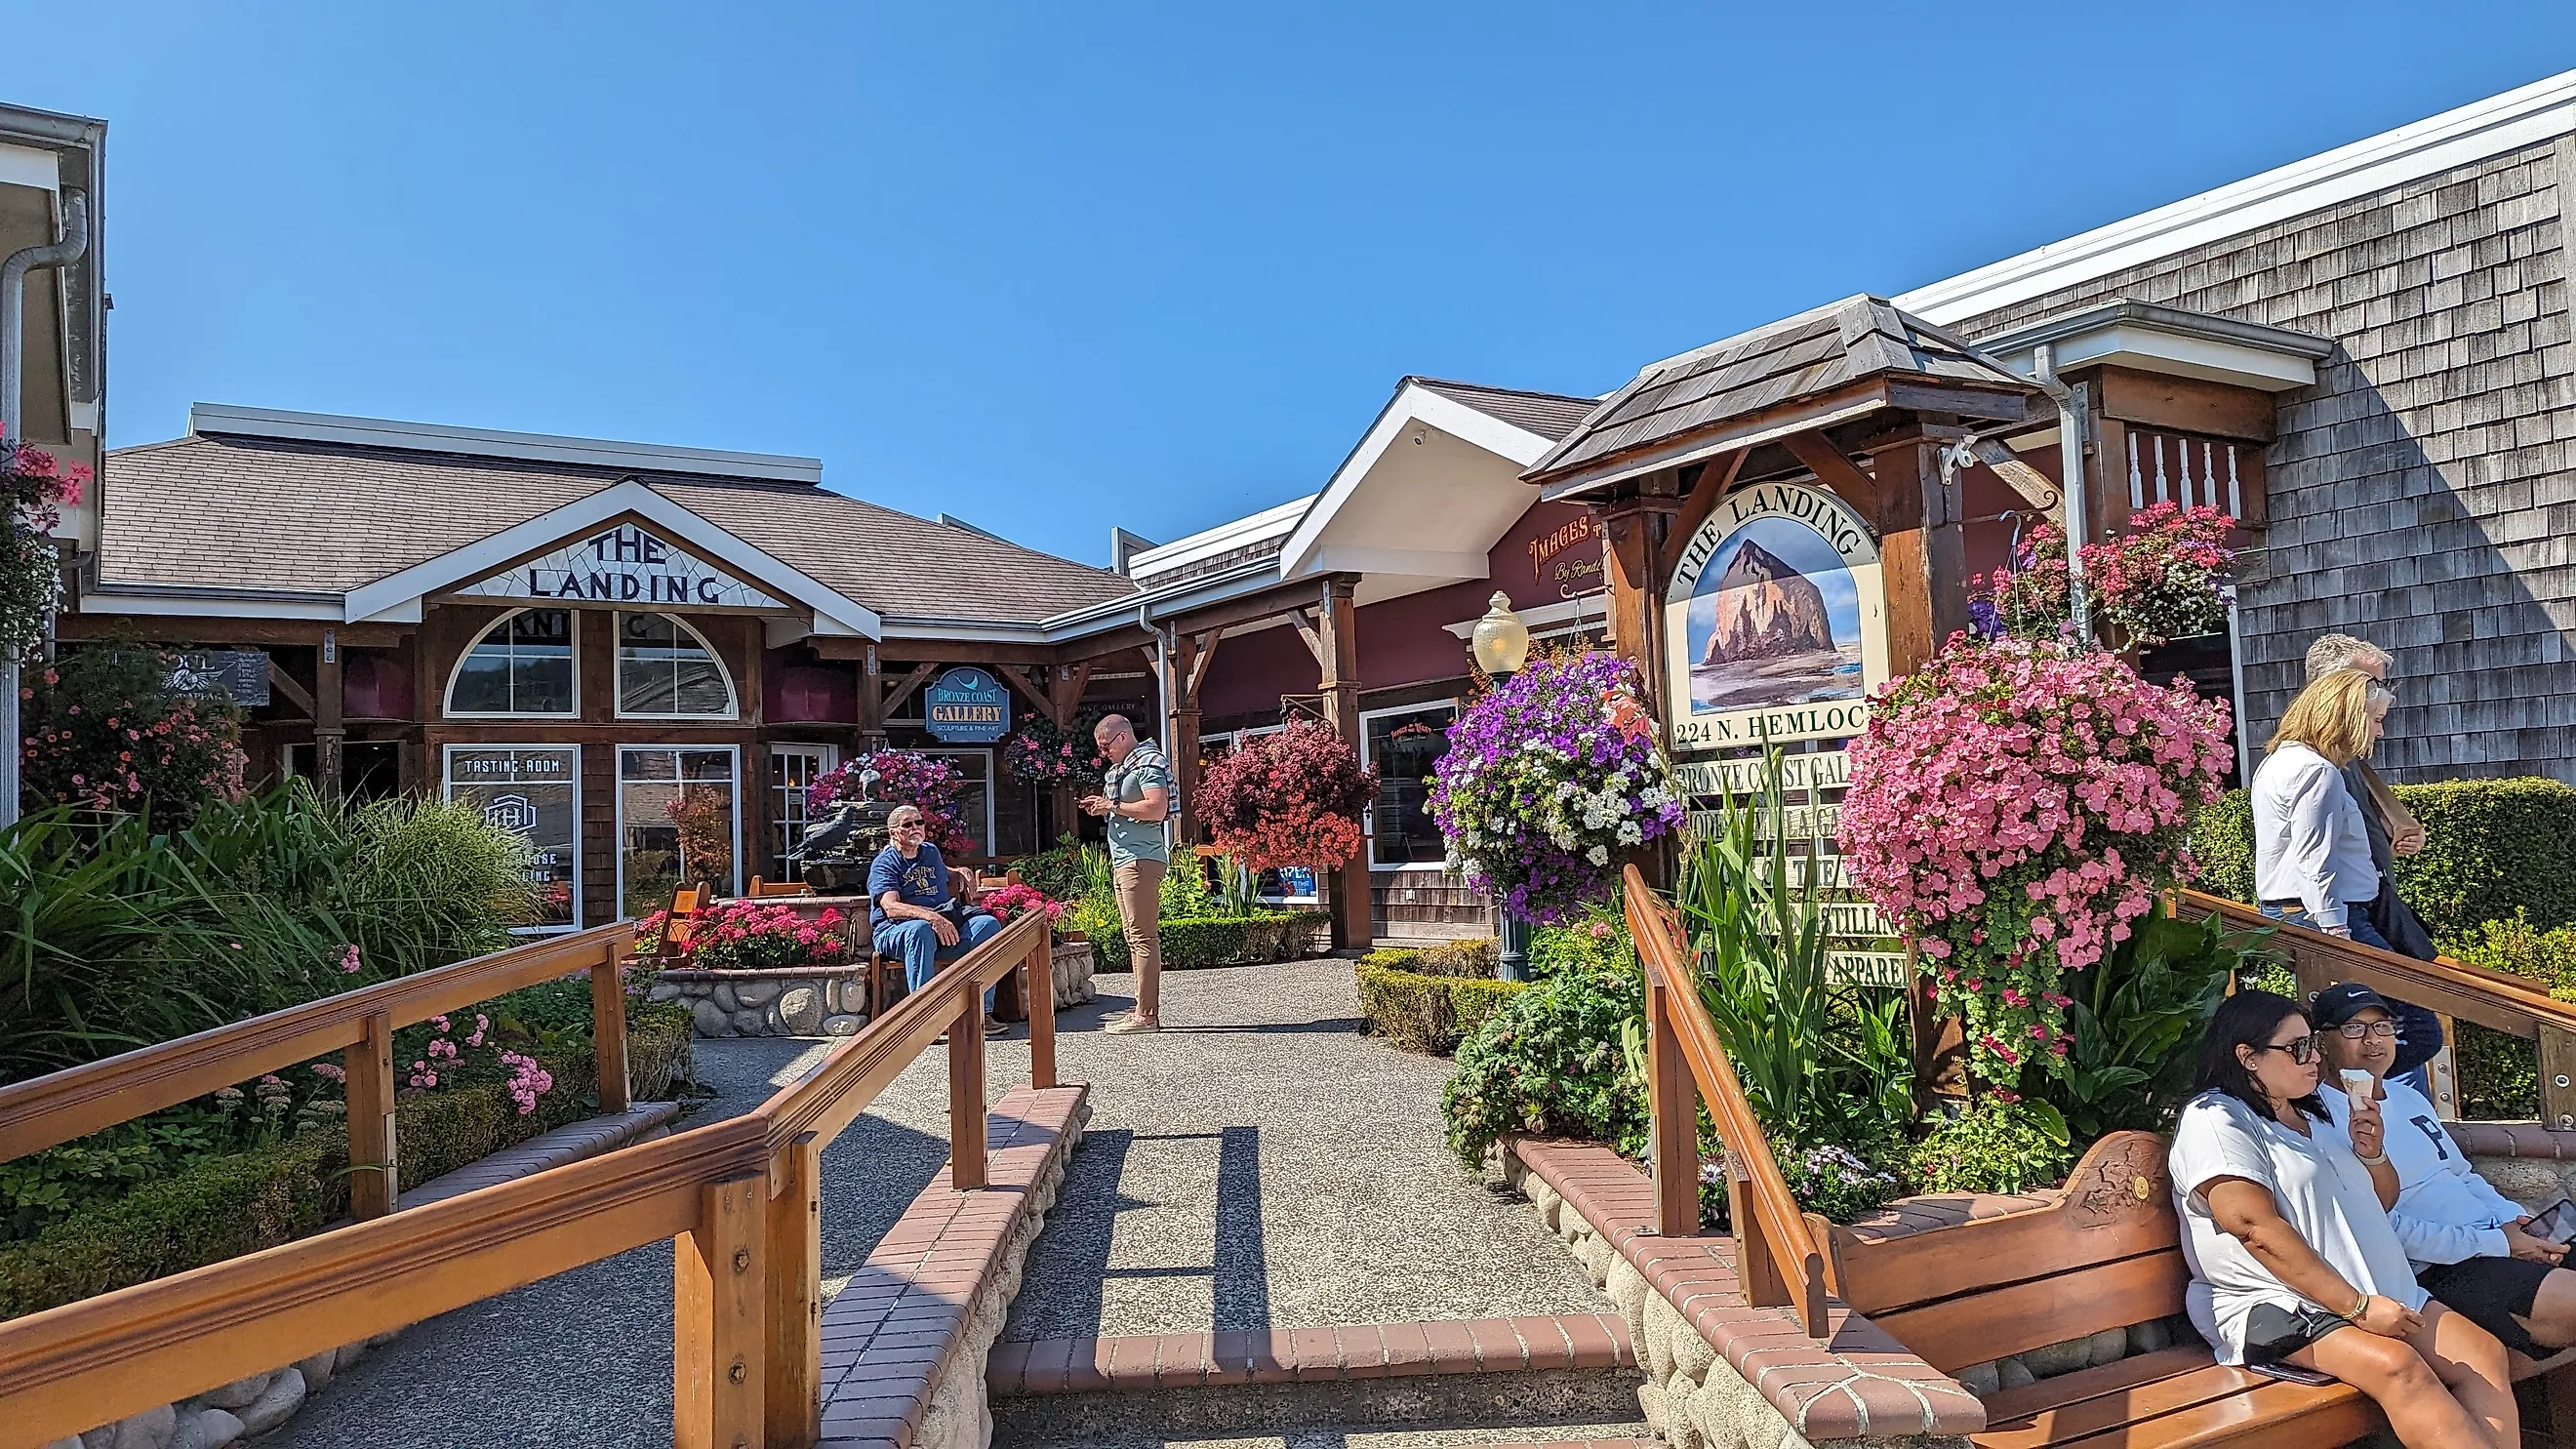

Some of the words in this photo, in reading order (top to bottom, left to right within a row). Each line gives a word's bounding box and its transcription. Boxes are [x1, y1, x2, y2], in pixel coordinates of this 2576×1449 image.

[587, 527, 666, 564] THE
[1528, 515, 1591, 585] IMAGES
[1676, 519, 1724, 587] THE
[1729, 485, 1862, 556] LANDING
[1554, 561, 1571, 583] By
[529, 569, 720, 604] LANDING
[937, 687, 970, 703] BRONZE
[971, 688, 997, 703] COAST
[1102, 703, 1136, 711] GALLERY
[932, 705, 1002, 722] GALLERY
[1675, 722, 1712, 745] 224
[1717, 718, 1739, 742] N.
[1748, 702, 1875, 736] HEMLOC
[464, 760, 519, 774] TASTING
[526, 760, 561, 773] ROOM
